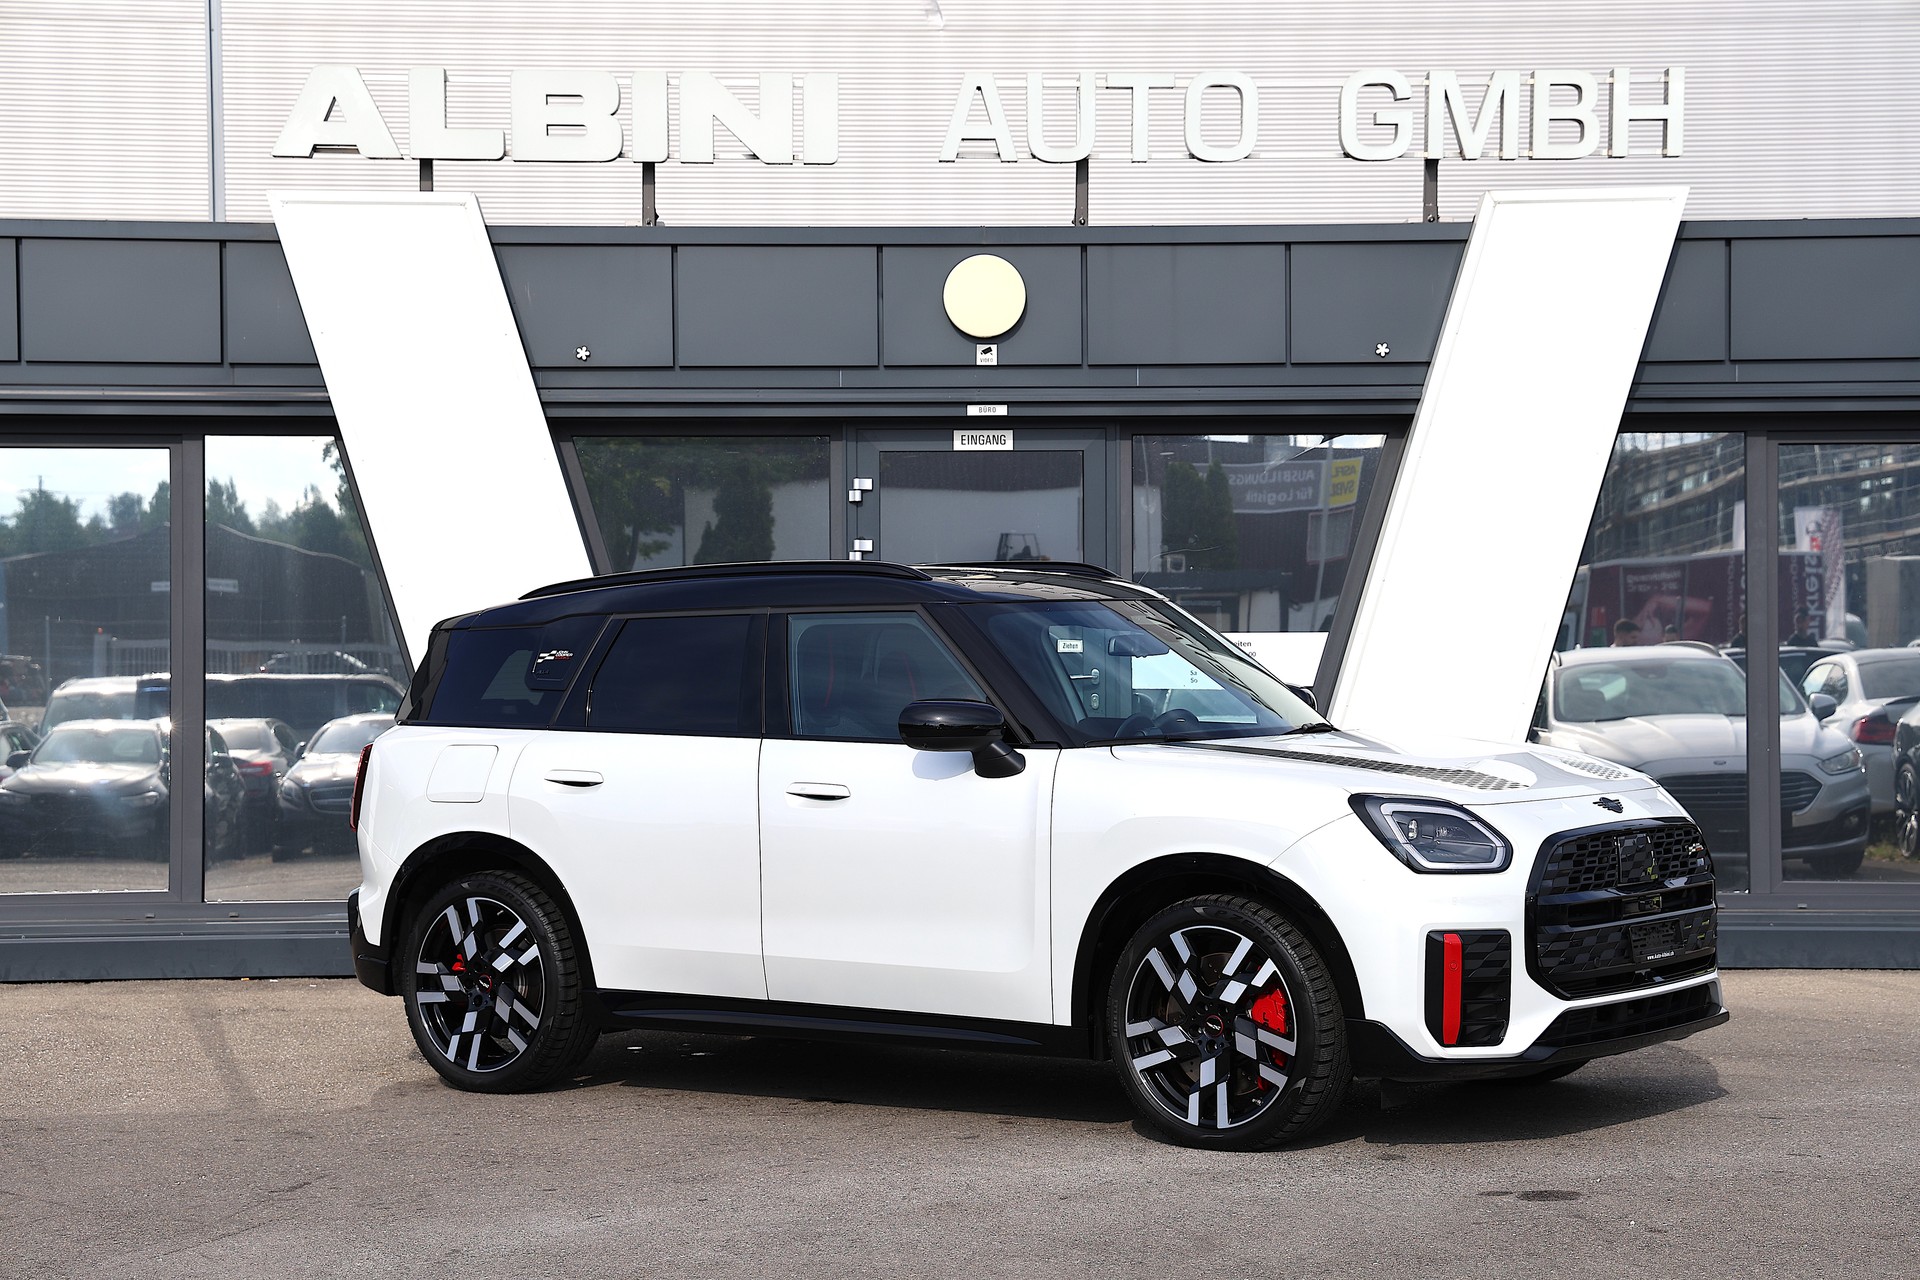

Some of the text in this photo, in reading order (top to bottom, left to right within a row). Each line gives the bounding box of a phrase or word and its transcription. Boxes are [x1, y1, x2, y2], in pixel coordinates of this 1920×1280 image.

[271, 65, 1687, 166] ALBINI AUTO GMBH
[978, 406, 997, 414] BÜRO
[960, 434, 1007, 446] EINGANG
